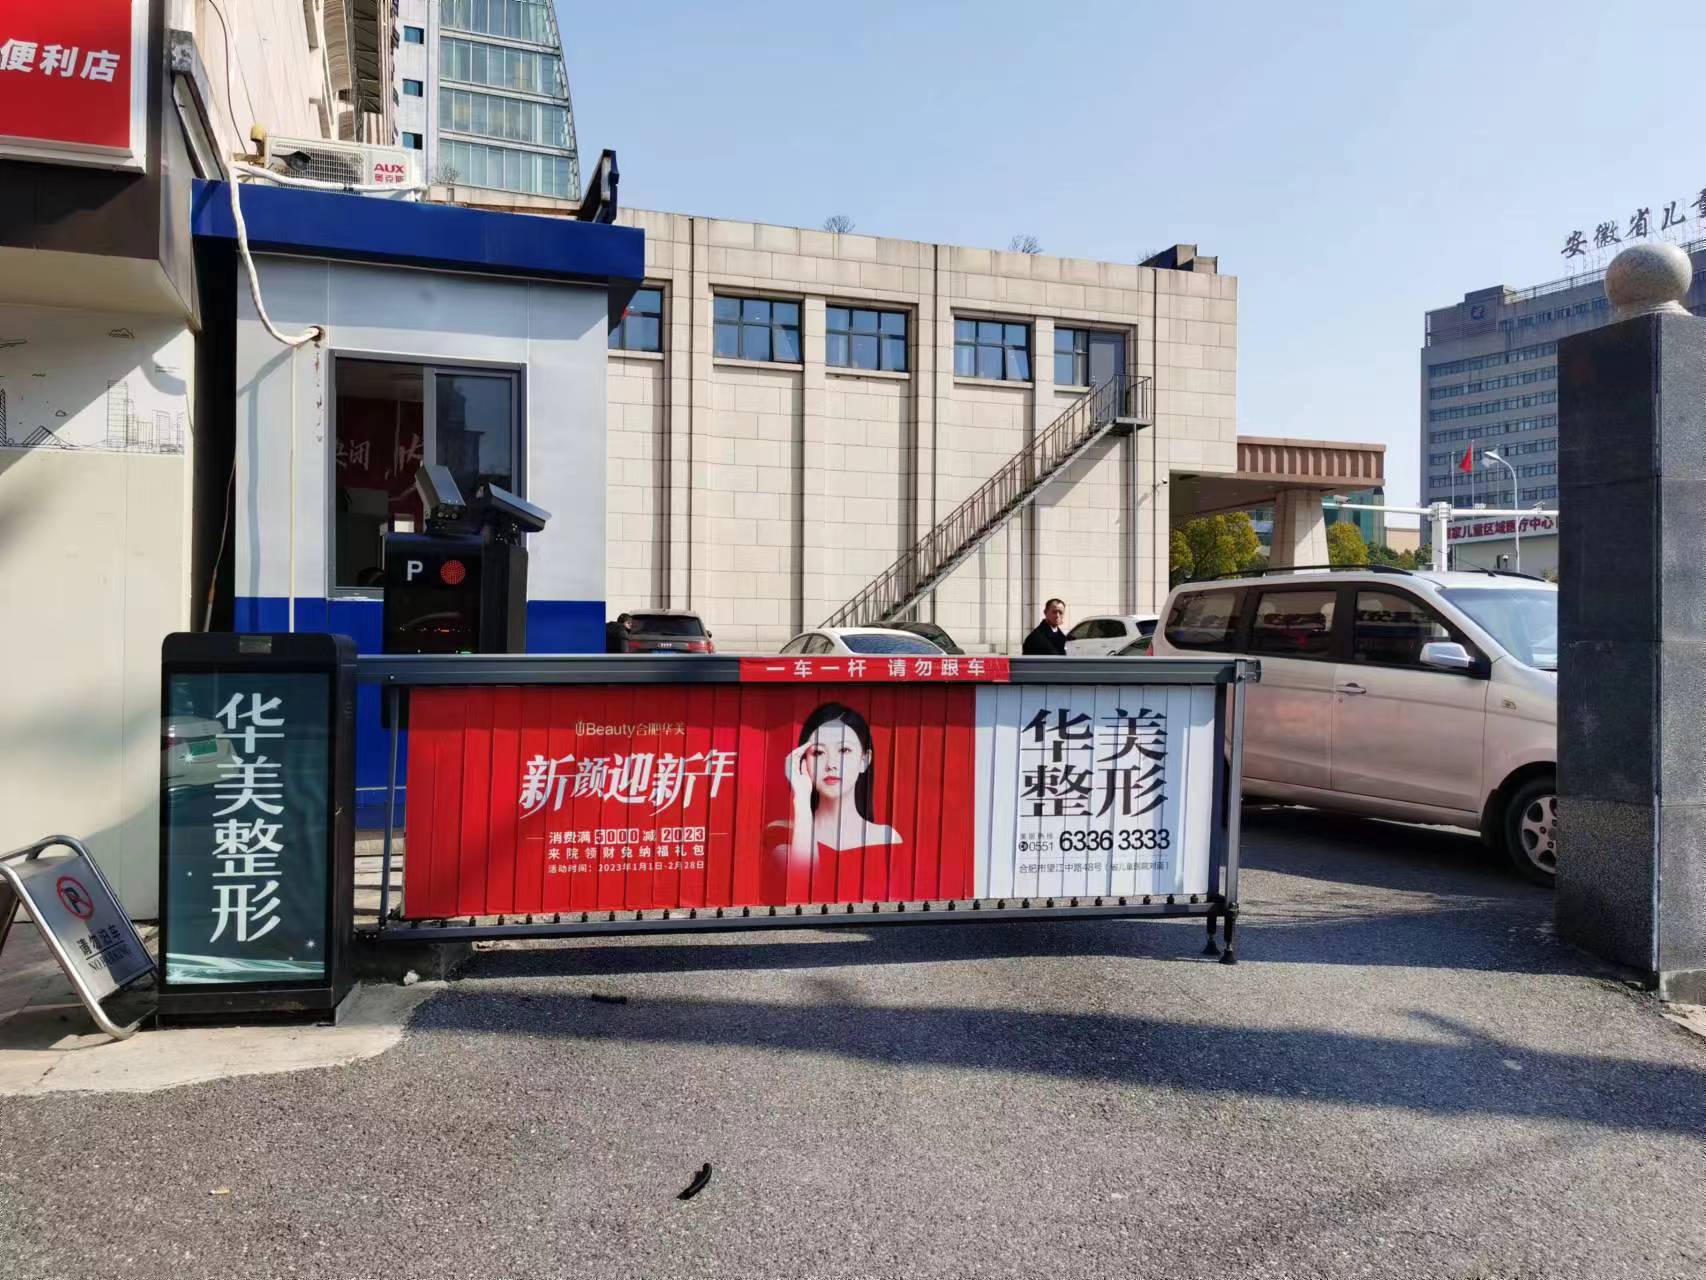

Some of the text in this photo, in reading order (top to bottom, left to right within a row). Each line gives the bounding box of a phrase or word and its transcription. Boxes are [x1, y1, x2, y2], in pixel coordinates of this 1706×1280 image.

[0, 38, 121, 82] 便利店
[374, 163, 404, 174] AUX
[406, 560, 424, 581] P
[766, 658, 986, 678] 一车一杆 请勿跟车
[1020, 708, 1169, 763] 华美
[518, 748, 738, 820] 新颜迎新年
[1020, 763, 1169, 818] 整形
[209, 692, 285, 943] 华美整形
[549, 827, 706, 844] 消费满 5000 减 2023
[1028, 829, 1170, 851] 0551 6336 3333
